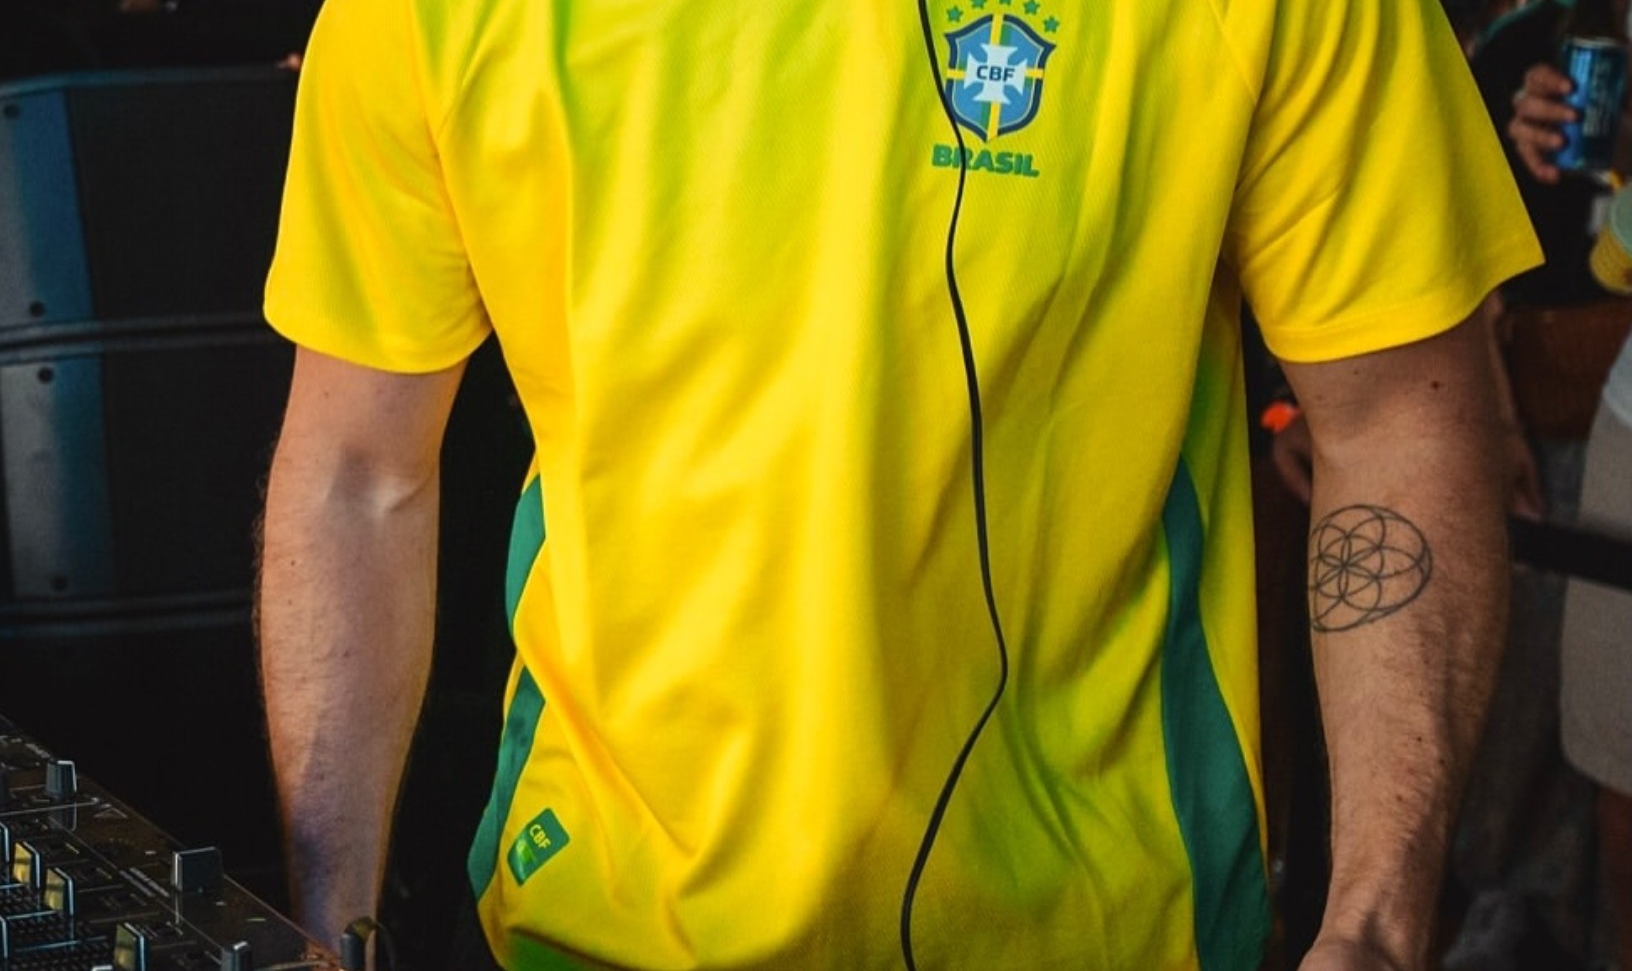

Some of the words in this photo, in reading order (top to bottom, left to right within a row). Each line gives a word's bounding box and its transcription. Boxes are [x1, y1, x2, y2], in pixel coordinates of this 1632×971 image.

[976, 65, 1015, 82] CBF
[931, 144, 1040, 177] BRASIL
[529, 824, 551, 849] CBF
